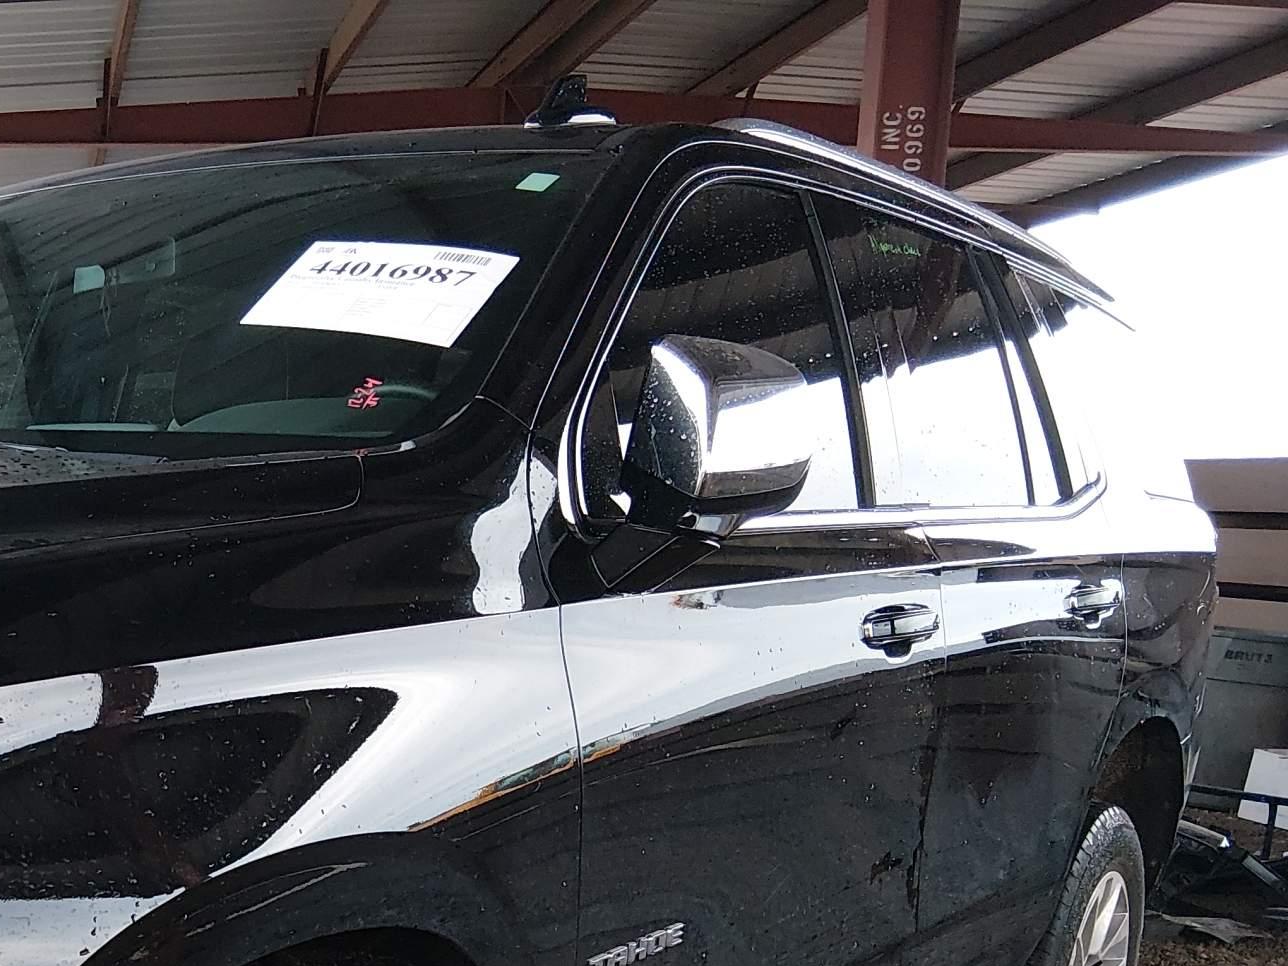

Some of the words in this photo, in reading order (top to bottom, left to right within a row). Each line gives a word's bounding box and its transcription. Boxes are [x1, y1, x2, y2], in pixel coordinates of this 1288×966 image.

[880, 104, 903, 150] INC.
[902, 106, 926, 172] 0969
[310, 259, 477, 287] 44016987
